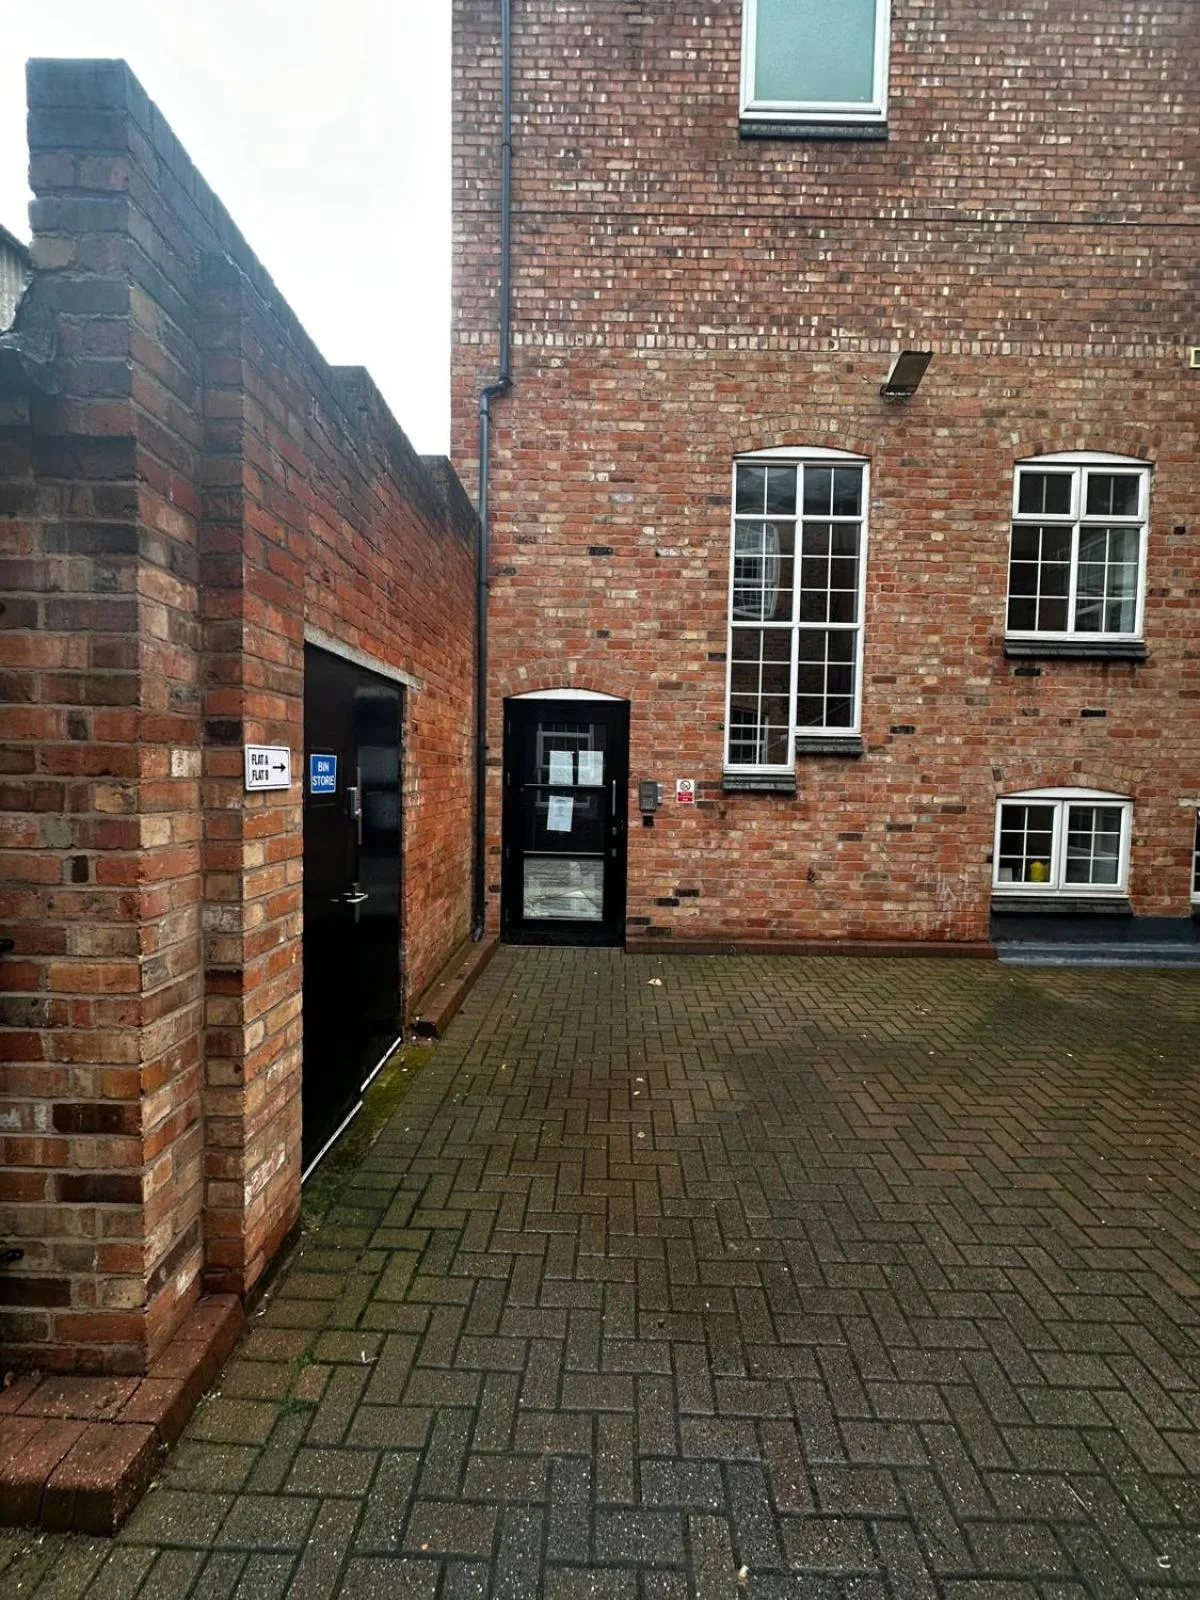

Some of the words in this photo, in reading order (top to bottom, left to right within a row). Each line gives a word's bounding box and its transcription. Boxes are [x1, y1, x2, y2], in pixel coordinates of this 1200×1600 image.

[252, 754, 264, 765] FLAT
[265, 754, 269, 765] A
[318, 761, 330, 772] BIN
[252, 770, 264, 780] FLAT
[265, 770, 269, 780] B
[312, 776, 334, 786] STORE
